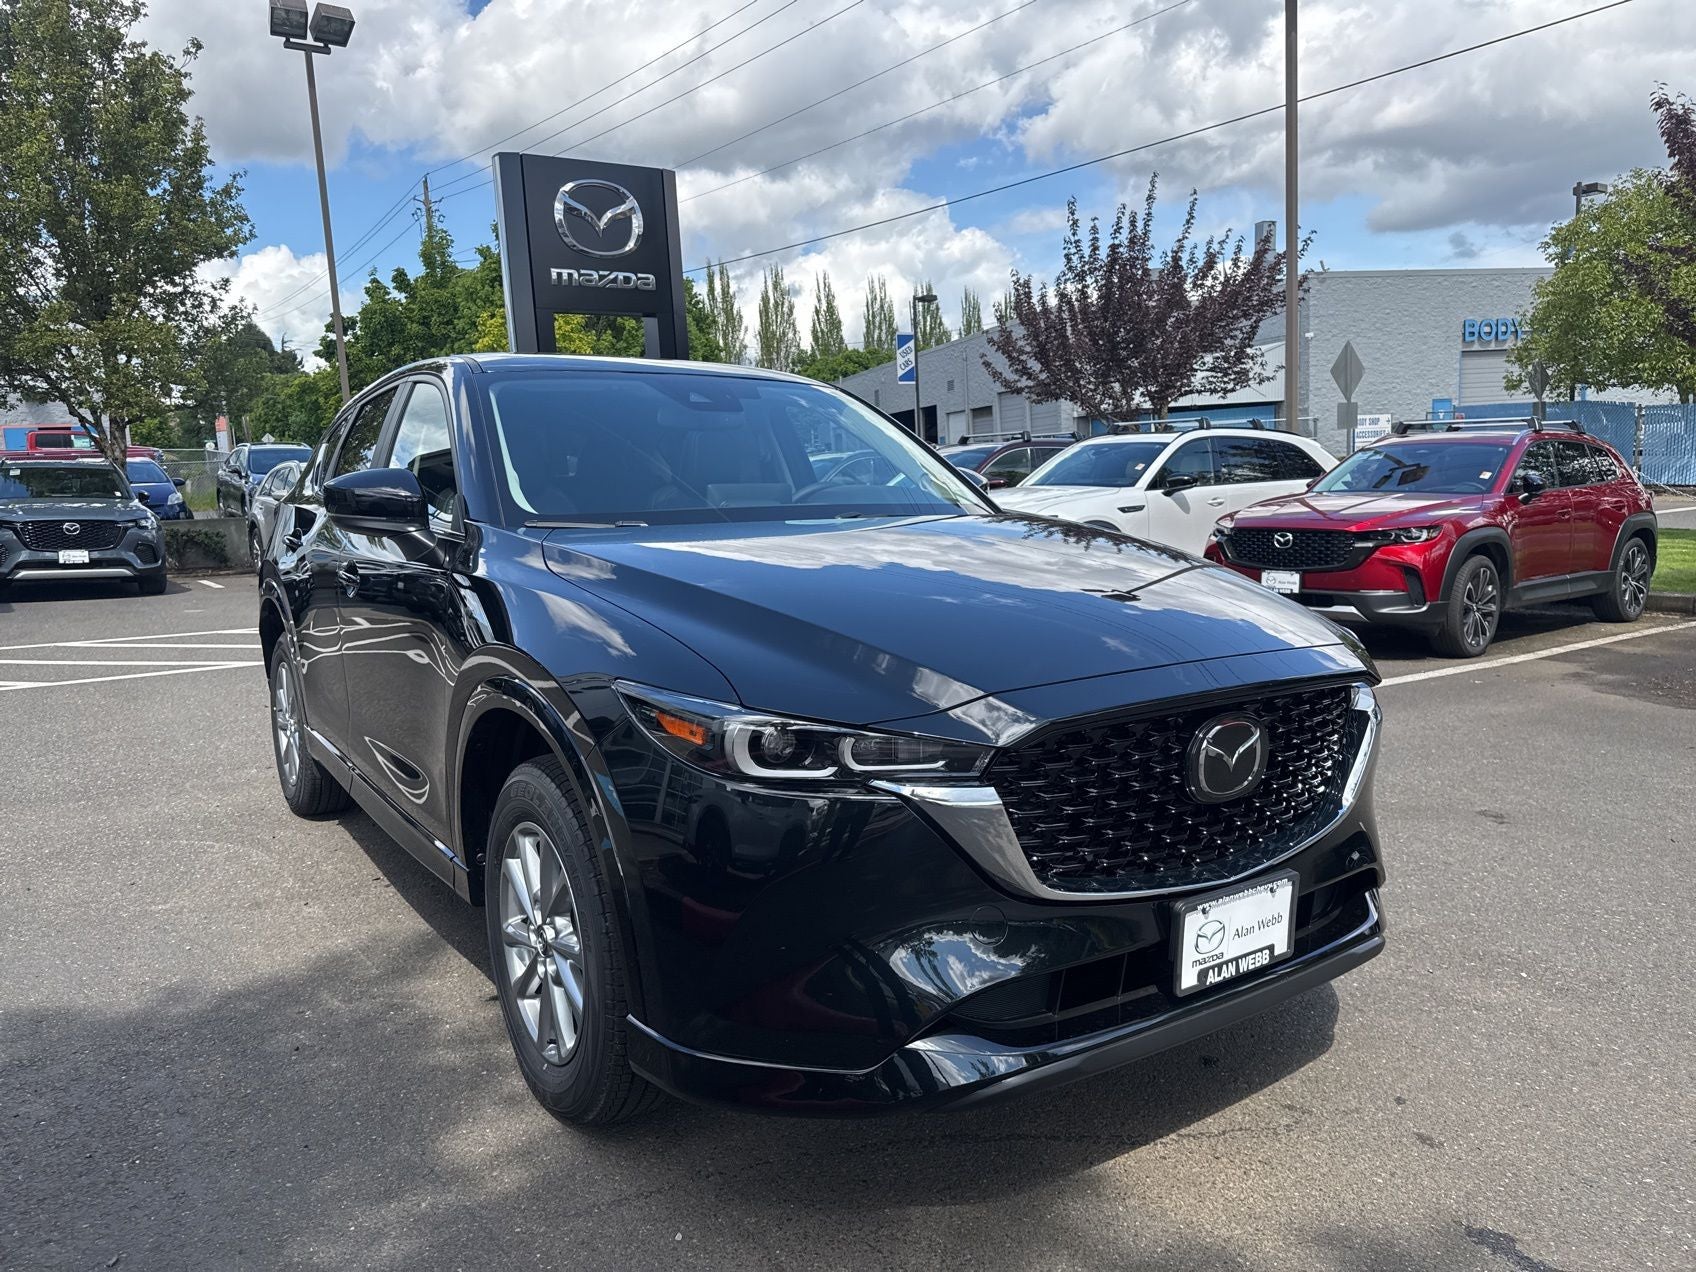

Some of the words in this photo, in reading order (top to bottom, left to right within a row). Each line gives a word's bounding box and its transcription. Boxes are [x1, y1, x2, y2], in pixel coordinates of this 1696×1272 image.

[549, 267, 656, 291] mazda
[1463, 318, 1523, 342] BODY
[899, 345, 913, 358] USED
[899, 358, 913, 371] CARS
[1358, 417, 1367, 426] ODY
[1368, 417, 1380, 426] SHOP
[1232, 924, 1255, 941] Alan
[1257, 912, 1283, 932] Webb
[1191, 951, 1224, 969] mazda
[1206, 960, 1236, 985] ALAN
[1238, 949, 1270, 974] WEBB
